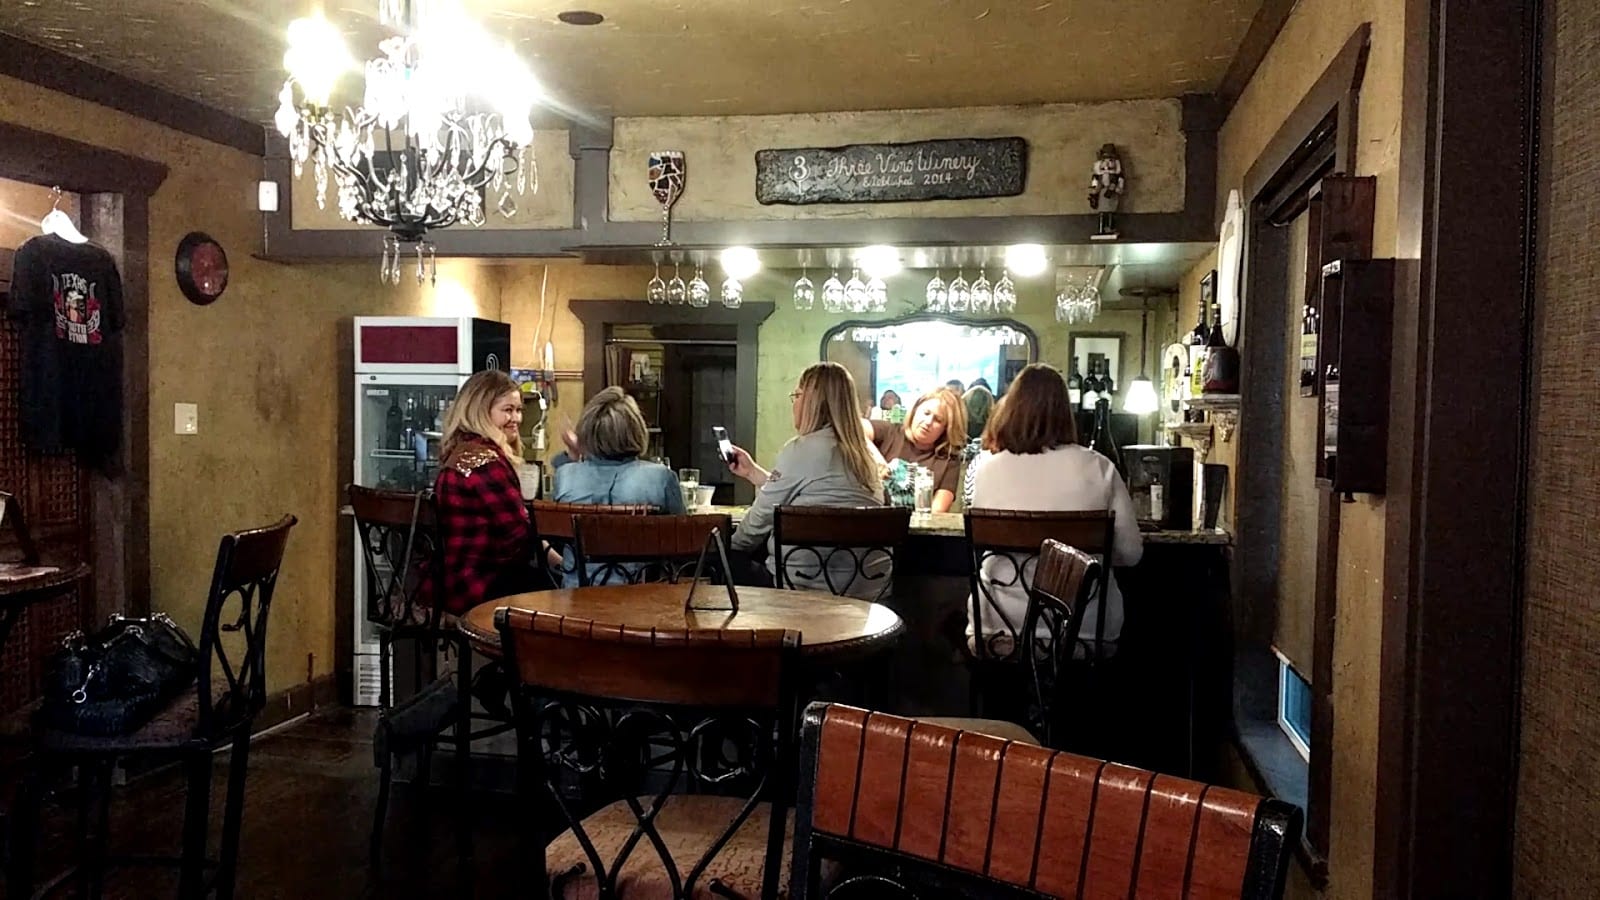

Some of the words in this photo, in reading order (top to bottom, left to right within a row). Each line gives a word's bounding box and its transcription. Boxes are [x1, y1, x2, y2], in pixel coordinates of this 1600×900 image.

[793, 155, 808, 180] 3
[826, 156, 874, 177] Three
[918, 150, 981, 180] Winery
[924, 172, 953, 185] 2014
